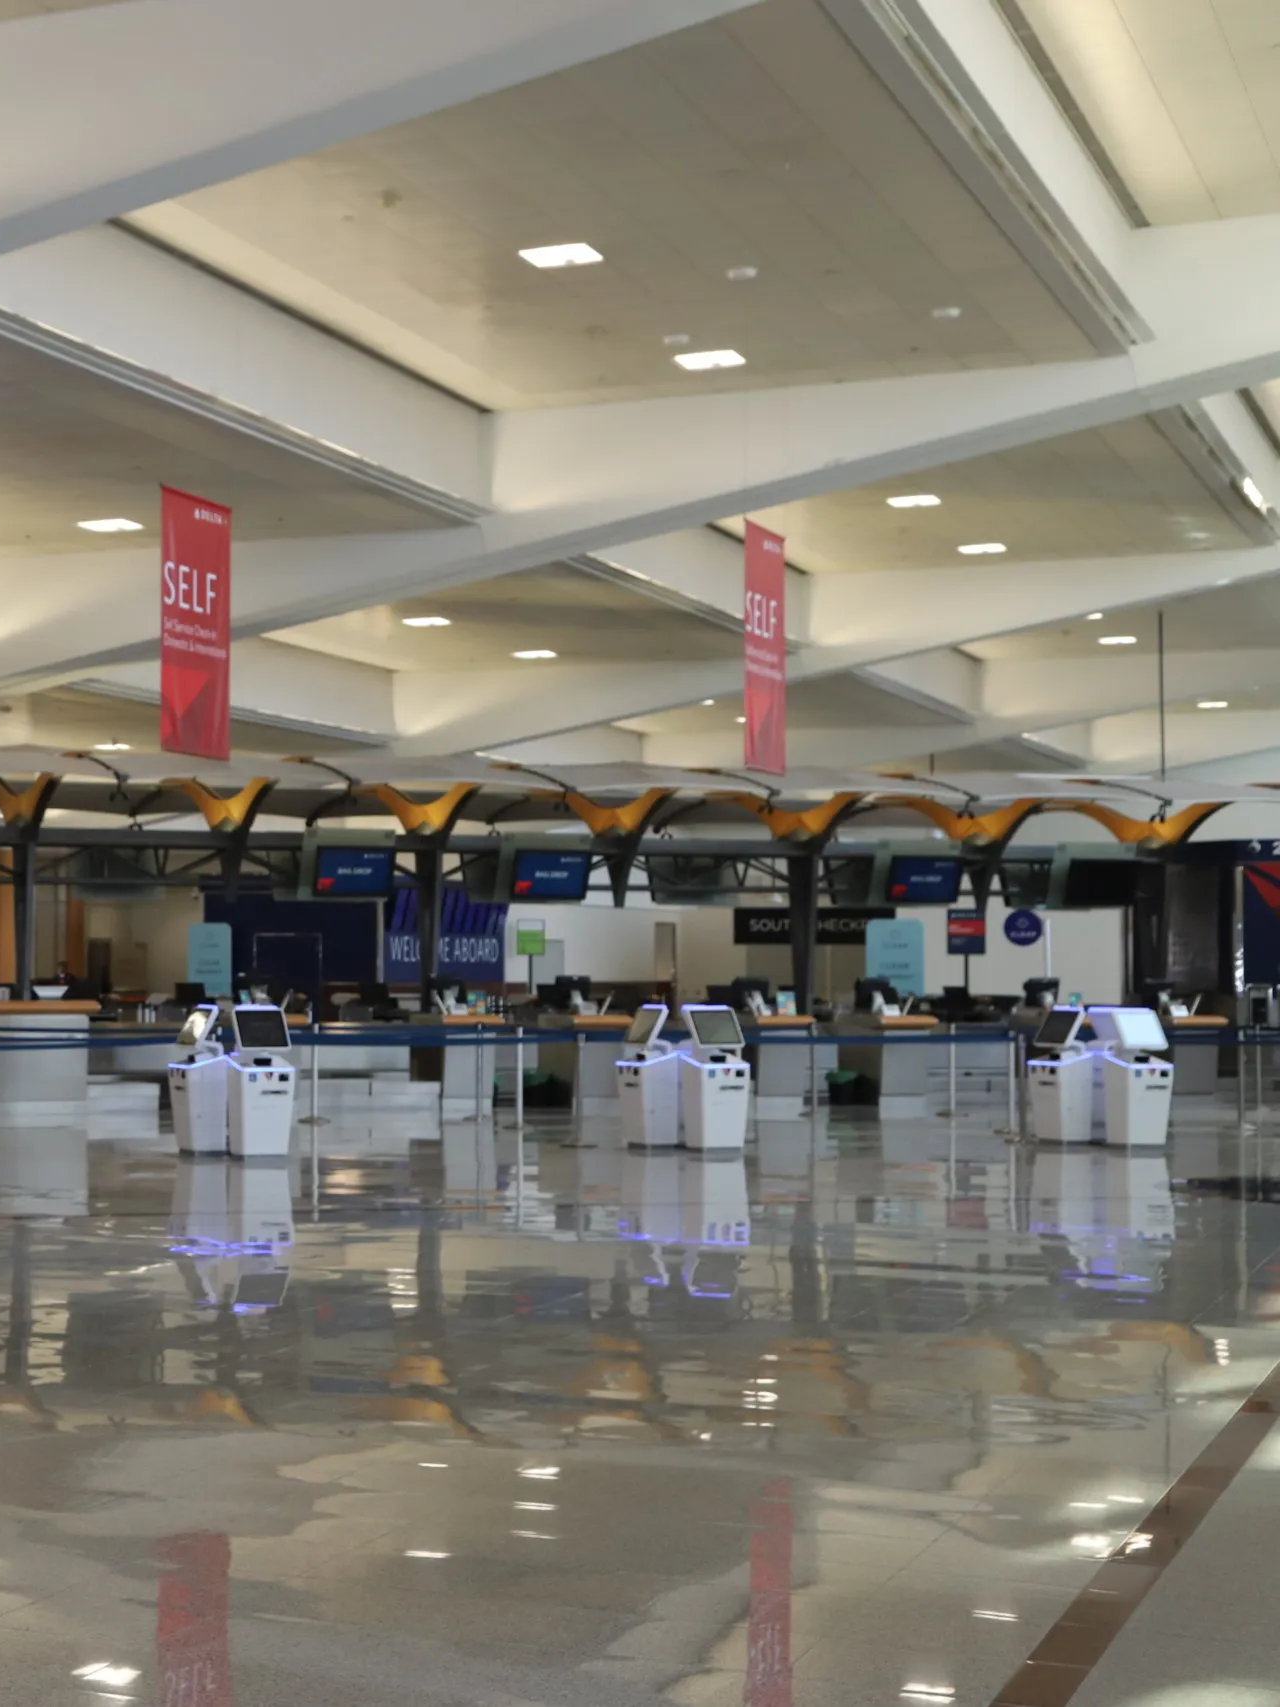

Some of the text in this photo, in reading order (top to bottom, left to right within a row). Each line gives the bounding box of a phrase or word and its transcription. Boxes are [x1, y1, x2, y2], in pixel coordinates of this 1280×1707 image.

[163, 560, 218, 615] SELF
[745, 590, 778, 640] SELF
[749, 918, 791, 932] SOUT
[453, 936, 500, 963] ABOARD
